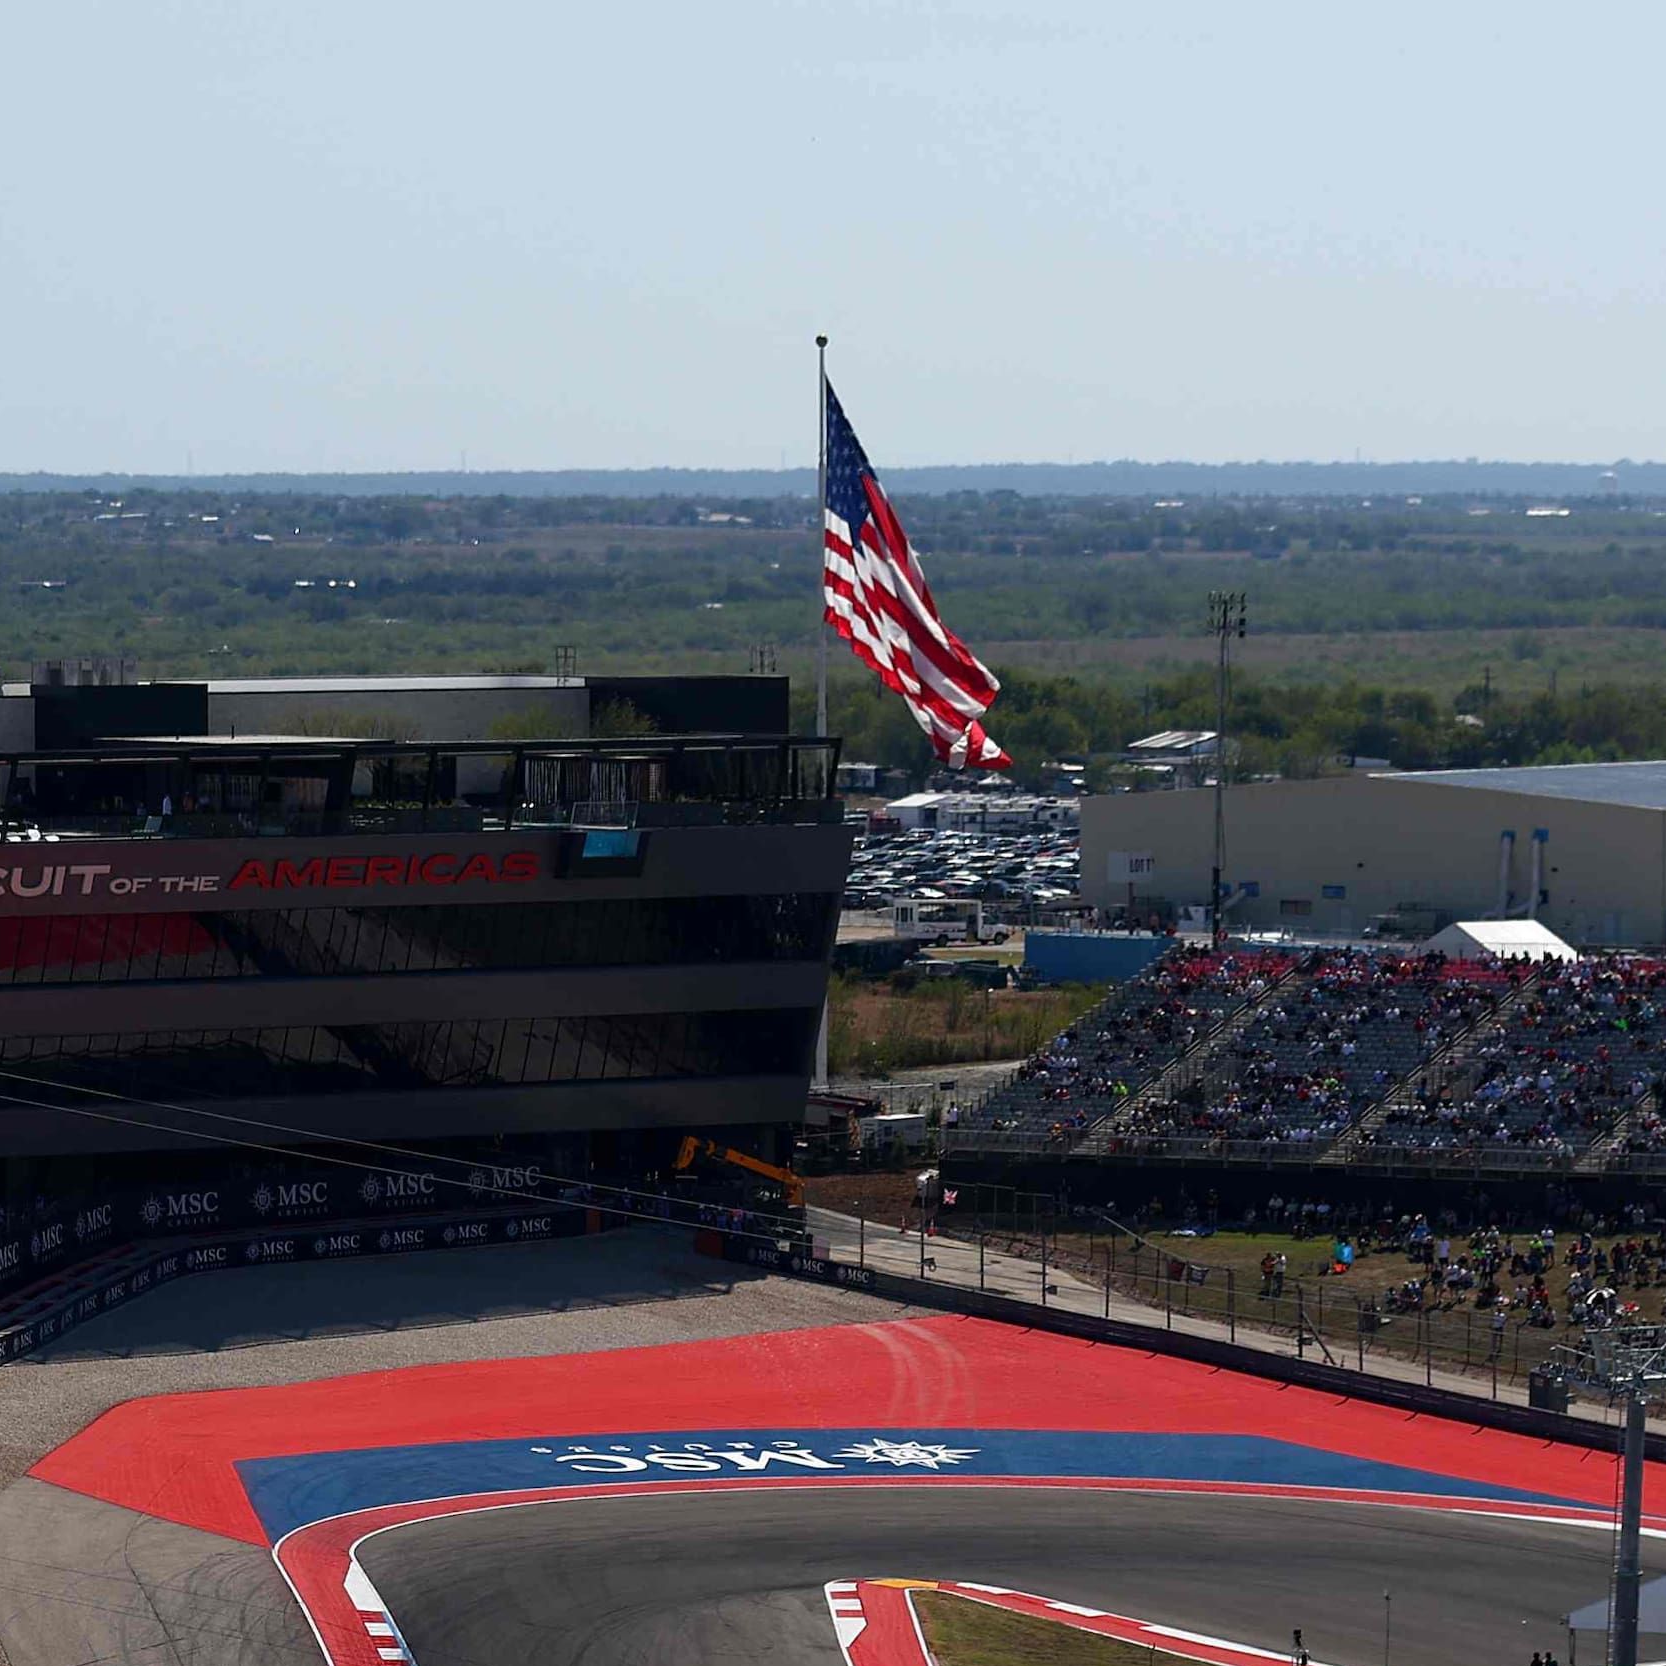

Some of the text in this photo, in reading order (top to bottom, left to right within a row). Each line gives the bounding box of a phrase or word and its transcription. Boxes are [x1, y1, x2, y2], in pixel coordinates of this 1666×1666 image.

[109, 876, 148, 895] OF
[158, 875, 219, 894] THE
[230, 852, 540, 890] AMERICAS
[385, 1172, 434, 1197] MSC
[492, 1166, 541, 1189] MSC
[167, 1191, 220, 1216] MSC
[278, 1181, 328, 1206] MSC
[87, 1204, 112, 1232] MSC
[521, 1217, 552, 1233] MSC
[41, 1224, 64, 1251] MSC
[393, 1229, 424, 1245] MSC
[458, 1223, 488, 1239] MSC
[262, 1240, 294, 1256] MSC
[329, 1234, 361, 1250] MSC
[195, 1247, 227, 1265] MSC
[802, 1257, 826, 1274] MSC
[847, 1268, 869, 1284] MSC
[556, 1448, 845, 1473] MSC
